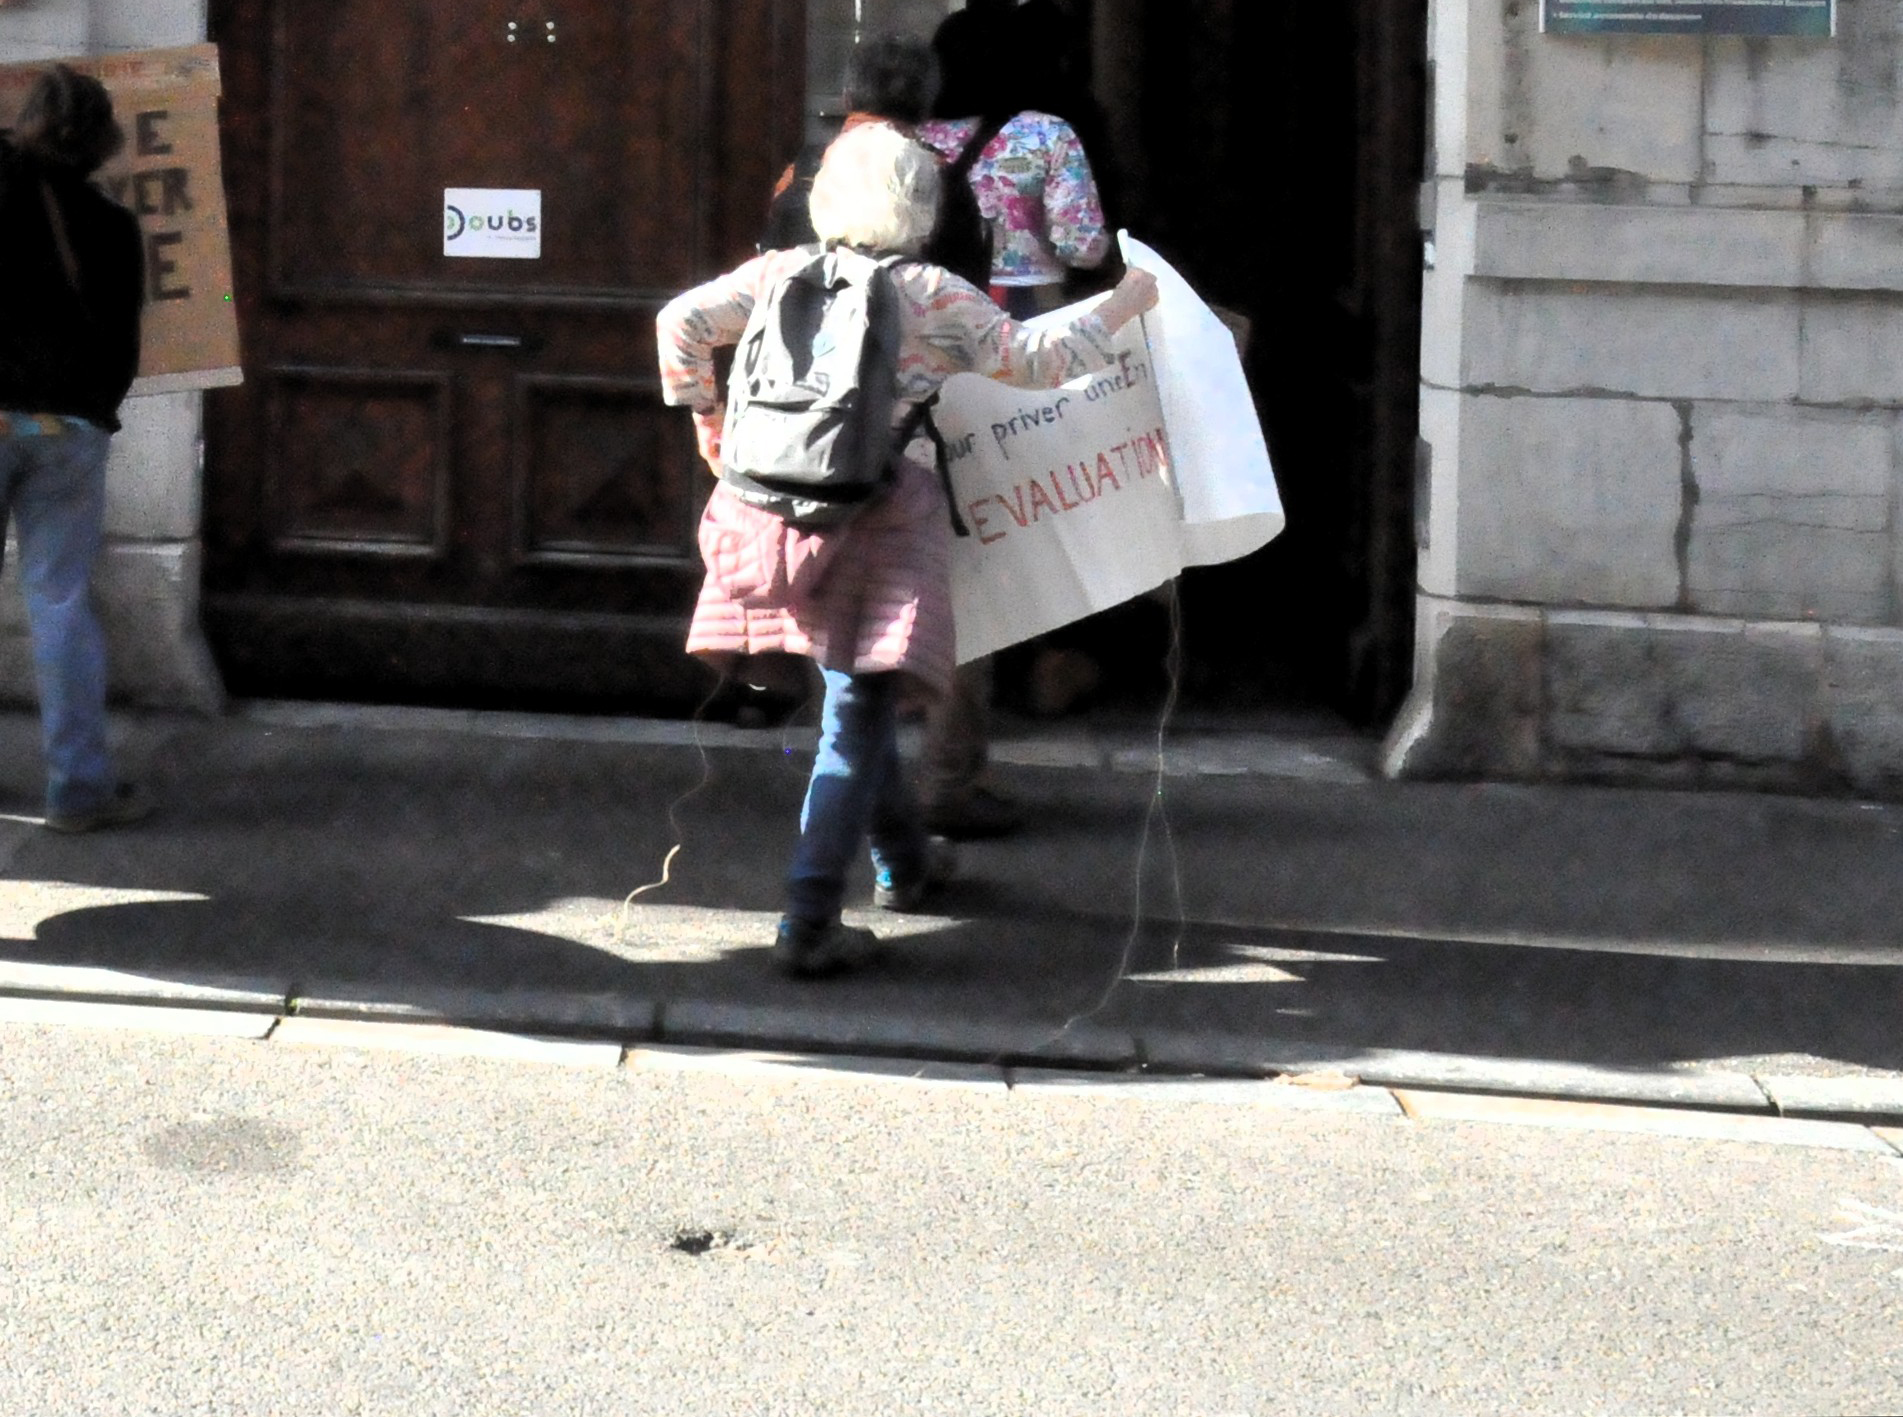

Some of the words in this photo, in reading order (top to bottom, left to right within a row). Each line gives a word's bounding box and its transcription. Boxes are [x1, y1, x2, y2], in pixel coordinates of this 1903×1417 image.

[447, 205, 537, 241] Doubs
[990, 396, 1071, 461] priver
[967, 426, 1173, 546] EVALUATION
